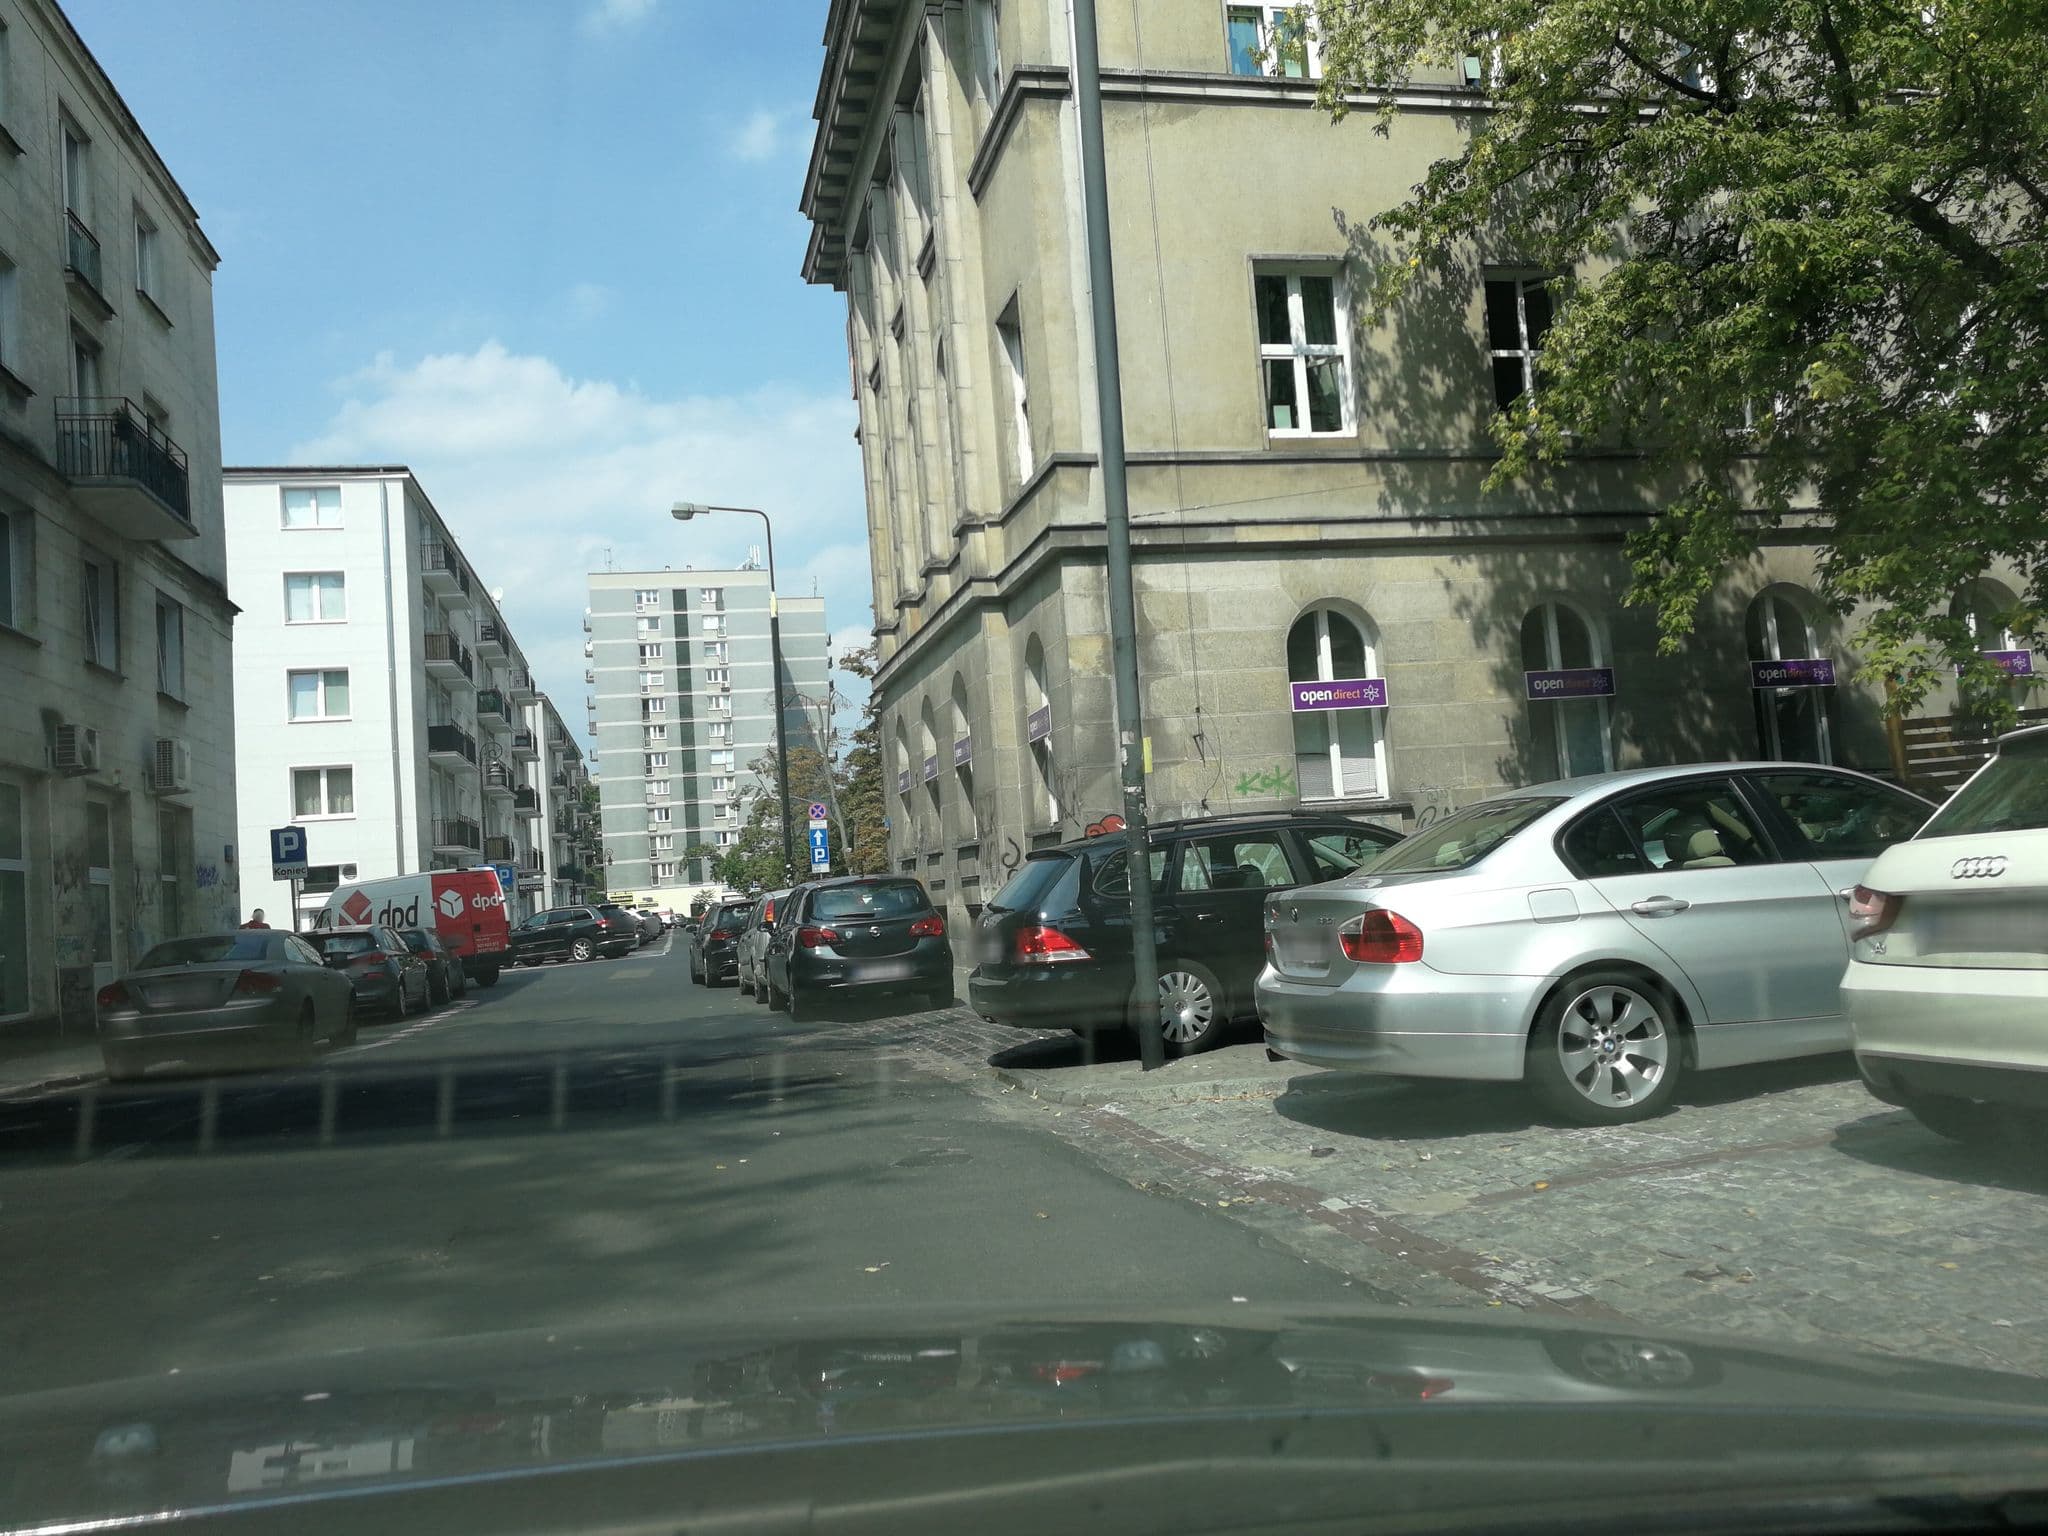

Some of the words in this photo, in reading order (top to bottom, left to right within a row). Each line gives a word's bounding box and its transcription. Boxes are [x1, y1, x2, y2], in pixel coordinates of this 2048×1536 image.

[1759, 668, 1787, 683] open
[1534, 679, 1564, 693] open
[1300, 690, 1333, 705] open
[1333, 689, 1360, 700] direct
[279, 832, 299, 859] P
[815, 848, 826, 863] P
[274, 867, 307, 877] Koniec
[472, 892, 501, 911] dpd
[379, 896, 419, 929] dpd
